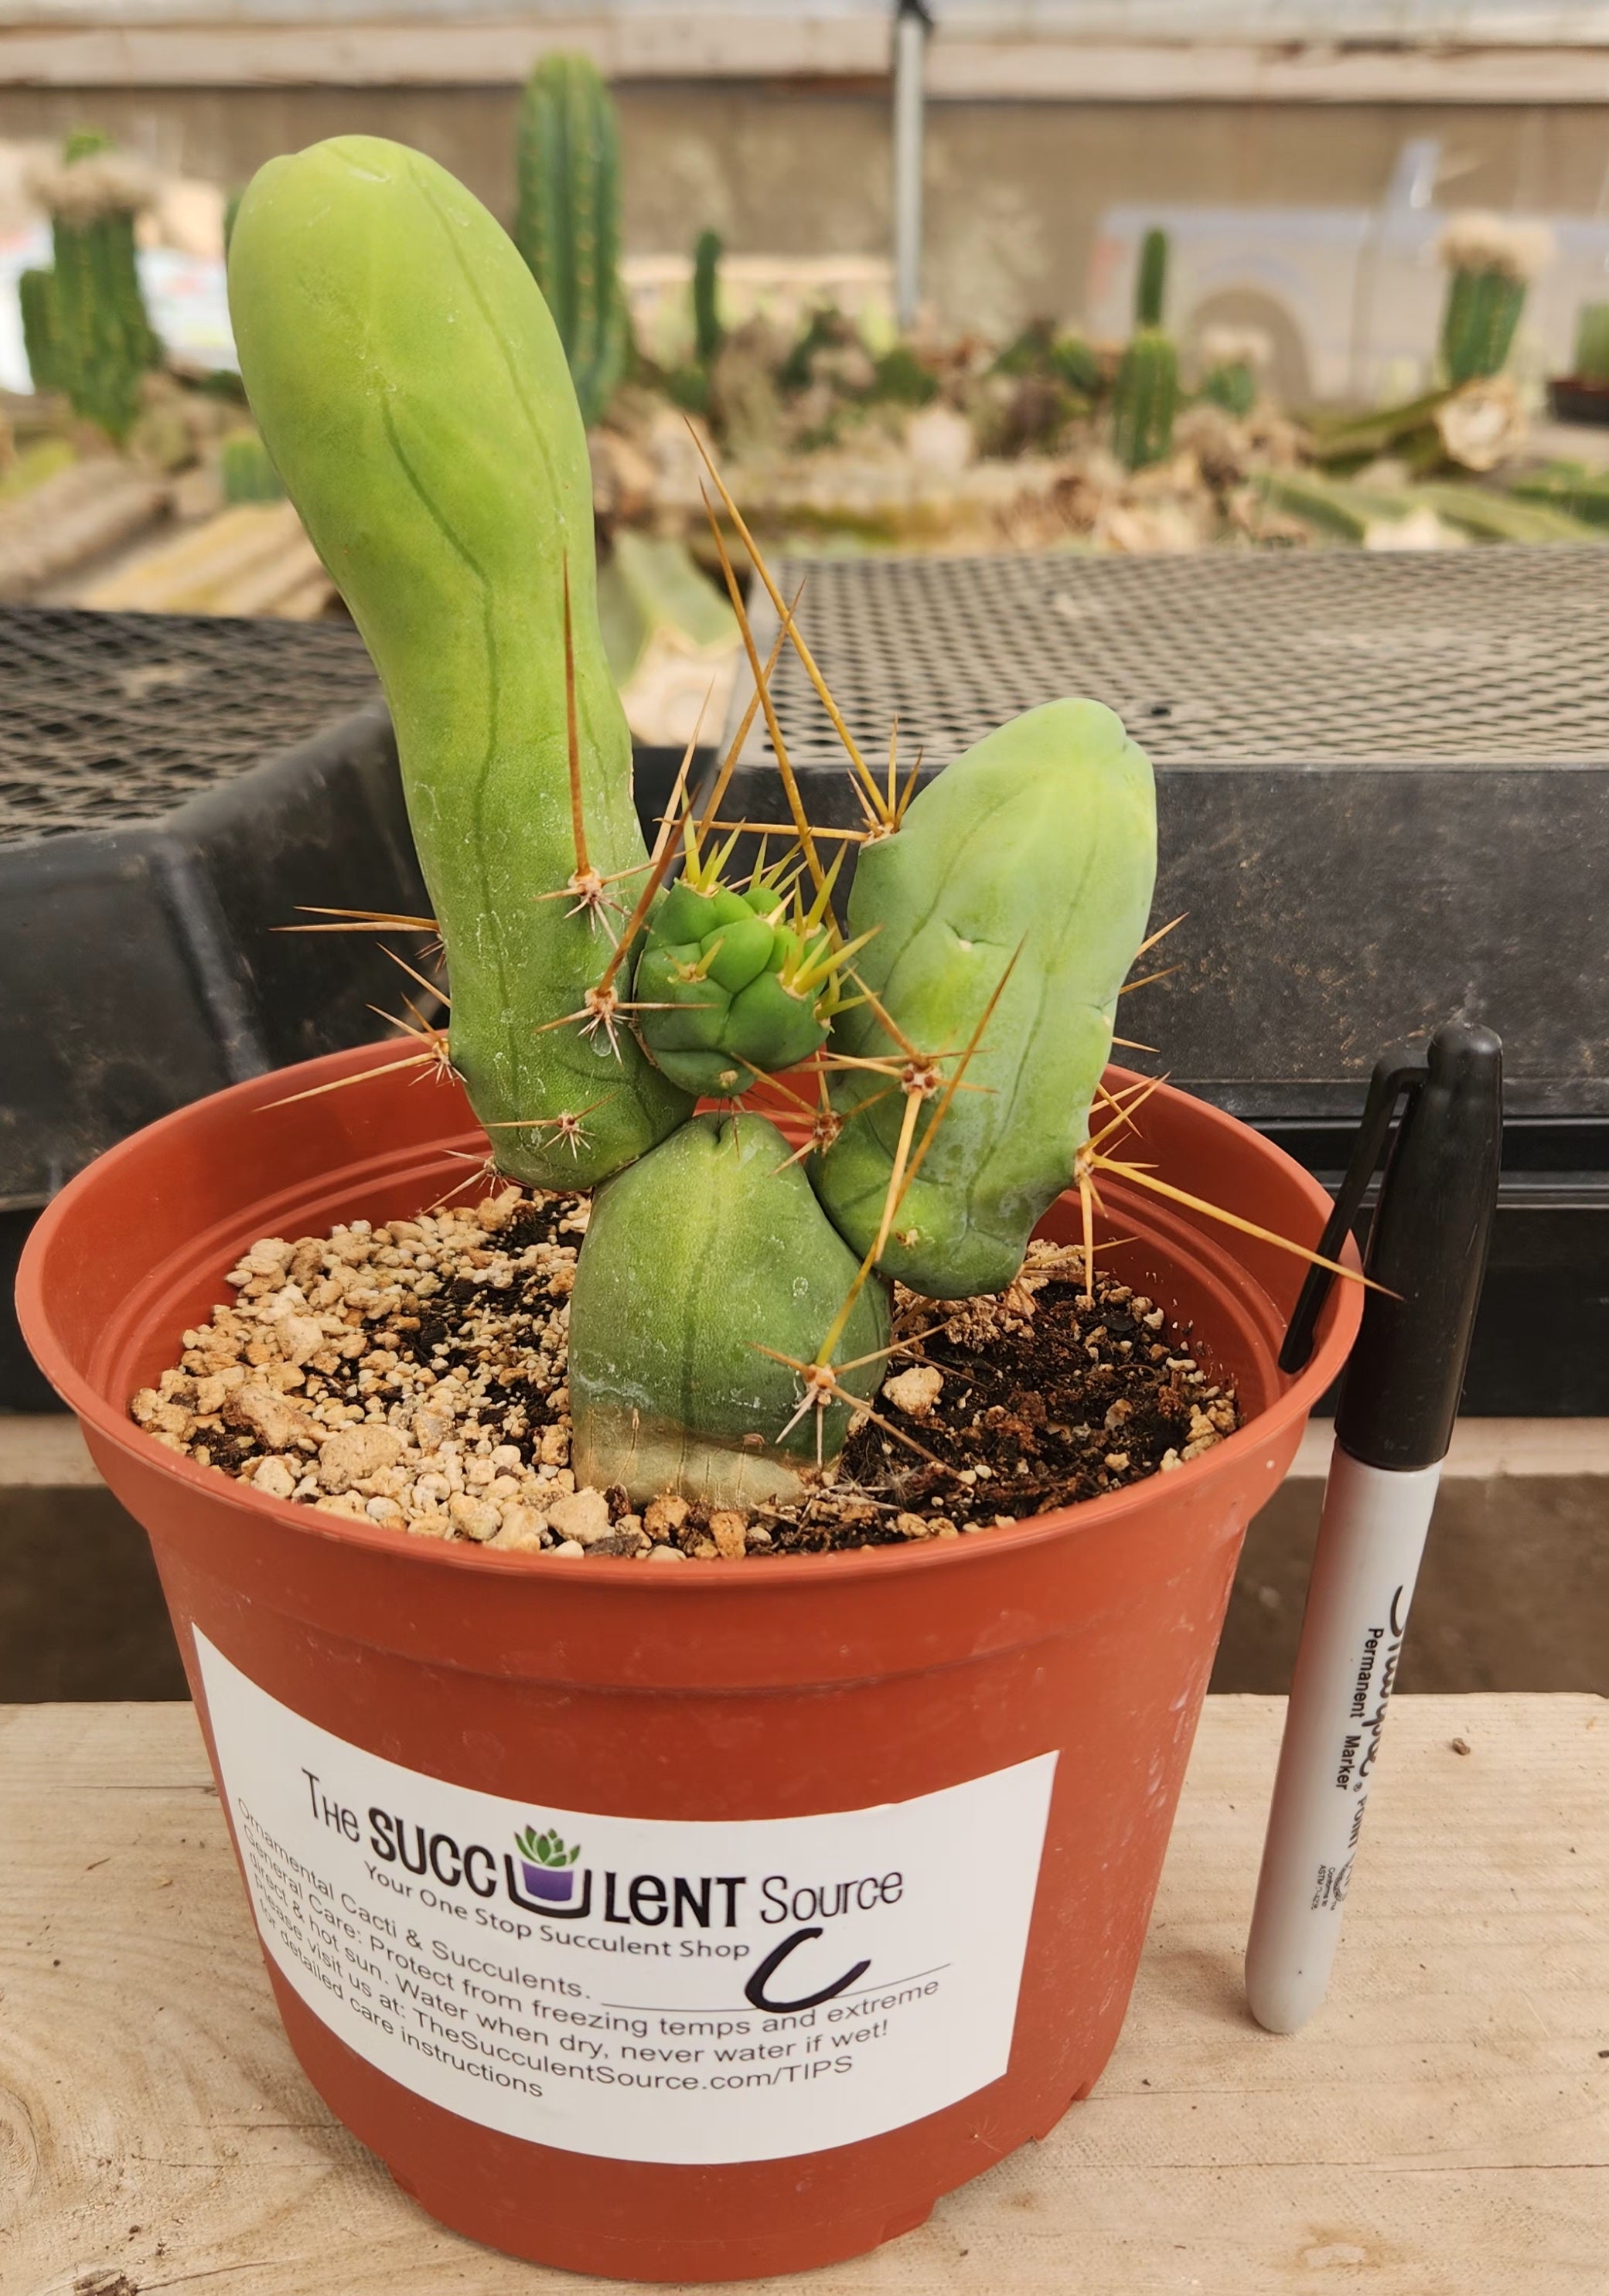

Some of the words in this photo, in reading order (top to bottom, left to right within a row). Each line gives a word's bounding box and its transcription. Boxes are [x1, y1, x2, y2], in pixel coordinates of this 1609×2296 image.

[1350, 1627, 1384, 1718] Permanent
[1336, 1735, 1361, 1790] Marker
[238, 1798, 334, 1900] Ornamental
[342, 1893, 397, 1938] Cacti
[406, 1929, 424, 1950] &
[432, 1940, 591, 1999] Succulents.
[244, 1824, 303, 1899] General
[309, 1894, 363, 1944] Care:
[370, 1935, 455, 1991] Protect
[462, 1979, 523, 2012] from
[533, 2000, 649, 2038] freezing
[660, 2014, 751, 2039] temps
[762, 2008, 816, 2032] and
[827, 1980, 939, 2023] extreme
[250, 1852, 288, 1907] direct
[293, 1900, 305, 1923] &
[309, 1915, 339, 1952] hot
[345, 1947, 390, 1985] sun.
[395, 1974, 469, 2020] Water
[476, 2012, 549, 2046] when
[560, 2035, 609, 2059] dry,
[621, 2045, 705, 2063] never
[714, 2041, 797, 2063] water
[806, 2035, 823, 2054] if
[831, 2020, 889, 2049] wet!
[363, 1860, 414, 1898] Your
[420, 1889, 468, 1920] One
[475, 1908, 532, 1940] Stop
[540, 1925, 672, 1956] Succulent
[680, 1940, 750, 1960] Shop
[759, 1872, 904, 1924] Source
[260, 1898, 276, 1930] for
[281, 1930, 344, 2000] detailed
[350, 1998, 394, 2035] care
[401, 2025, 544, 2097] instructions
[308, 1938, 343, 1977] visit
[349, 1973, 373, 1998] us
[380, 1994, 406, 2018] at:
[412, 2008, 854, 2090] TheSucculentSource.com/TIPS
[745, 1926, 872, 2014] C
